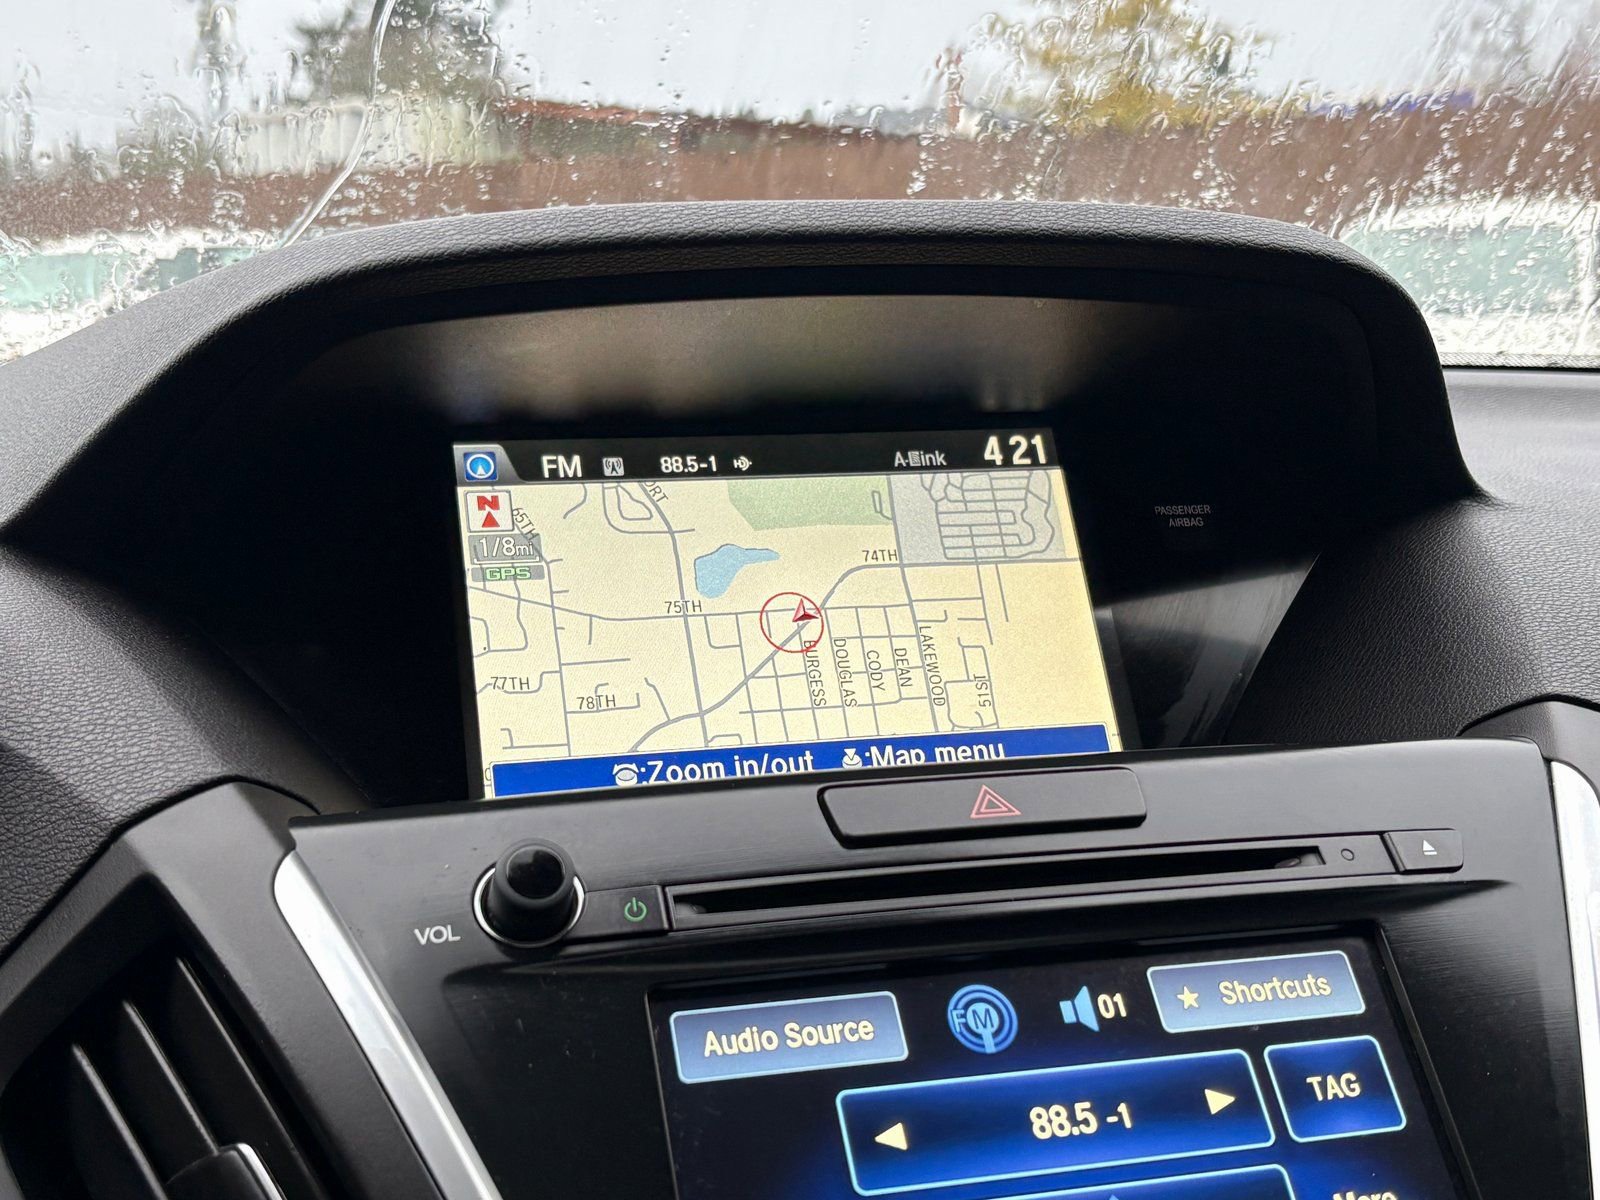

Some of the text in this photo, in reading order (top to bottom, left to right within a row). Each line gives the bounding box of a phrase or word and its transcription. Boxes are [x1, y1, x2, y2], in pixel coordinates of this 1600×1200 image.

[541, 455, 582, 478] FM
[660, 455, 717, 473] 88.5-1
[476, 495, 500, 511] N
[1155, 504, 1212, 515] PASSENGER
[1169, 517, 1204, 528] AIRBAG
[861, 549, 898, 563] 74TH
[485, 566, 532, 581] GPS
[664, 600, 703, 614] 75TH
[803, 640, 827, 707] BURGESS
[833, 638, 857, 707] DOUGLAS
[866, 649, 886, 691] CODY
[894, 647, 913, 688] DEAN
[918, 625, 946, 707] LAKEWOOD
[491, 676, 530, 691] 77TH
[973, 673, 991, 707] 51ST
[576, 694, 616, 710] 78TH
[734, 751, 814, 776] in/out
[934, 743, 1006, 762] menu
[414, 924, 461, 945] VOL
[1218, 973, 1332, 1005] Shortcuts
[1098, 992, 1127, 1020] 01
[704, 1019, 875, 1057] Audio Source
[1306, 1073, 1361, 1100] TAG
